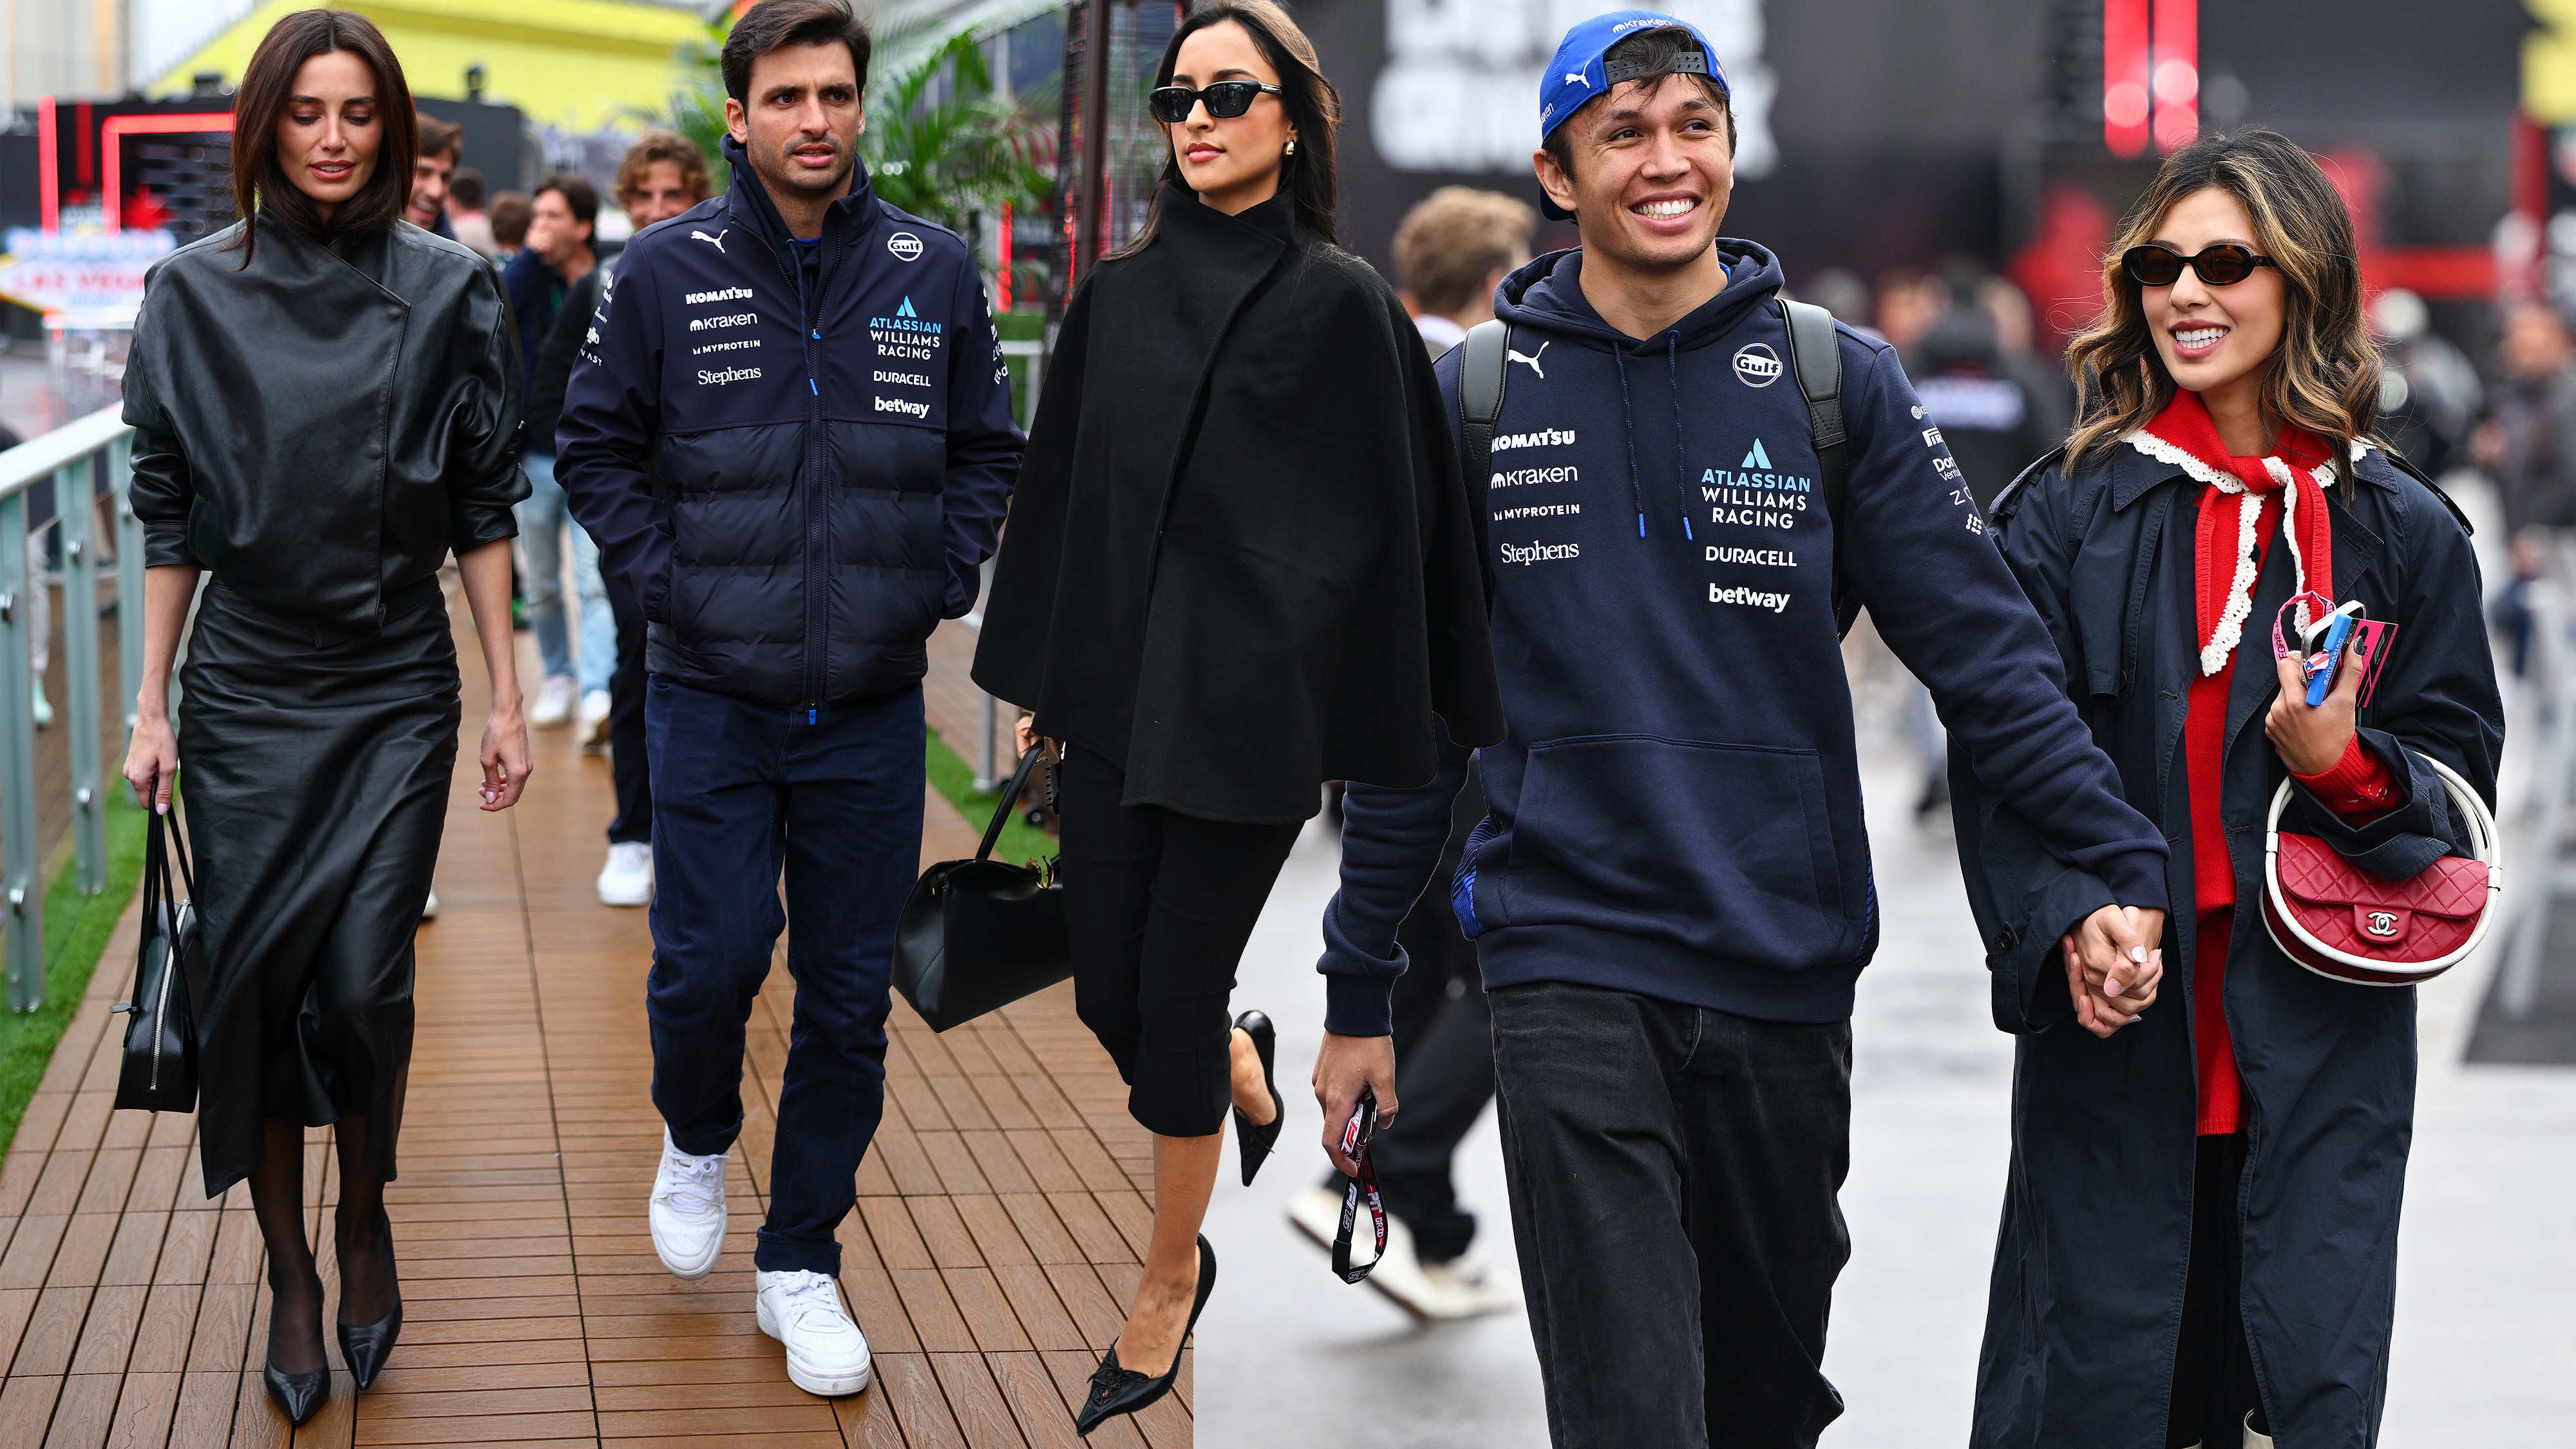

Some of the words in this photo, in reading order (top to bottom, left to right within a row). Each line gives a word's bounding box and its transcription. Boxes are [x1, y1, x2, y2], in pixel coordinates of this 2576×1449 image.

[891, 241, 921, 252] Gulf
[77, 268, 146, 294] VEG
[686, 287, 753, 305] KOMATSU
[869, 317, 942, 334] ATLASSIAN
[703, 339, 761, 354] MYPROTEIN
[870, 330, 940, 348] WILLIAMS
[878, 345, 931, 360] RACING
[697, 365, 762, 386] Stephens
[1738, 356, 1780, 375] Gulf
[873, 370, 931, 386] DURACELL
[875, 395, 930, 419] betway
[1492, 428, 1575, 453] KOMATSU
[1701, 468, 1810, 492] ATLASSIAN
[1701, 486, 1807, 511] WILLIAMS
[1504, 504, 1580, 519] MYPROTEIN
[1712, 507, 1794, 529] RACING
[1501, 540, 1580, 565] Stephens
[1705, 545, 1798, 567] DURACELL
[1709, 582, 1791, 613] betway
[2325, 638, 2342, 679] ATLASSIAN
[1375, 1217, 1385, 1238] GRID
